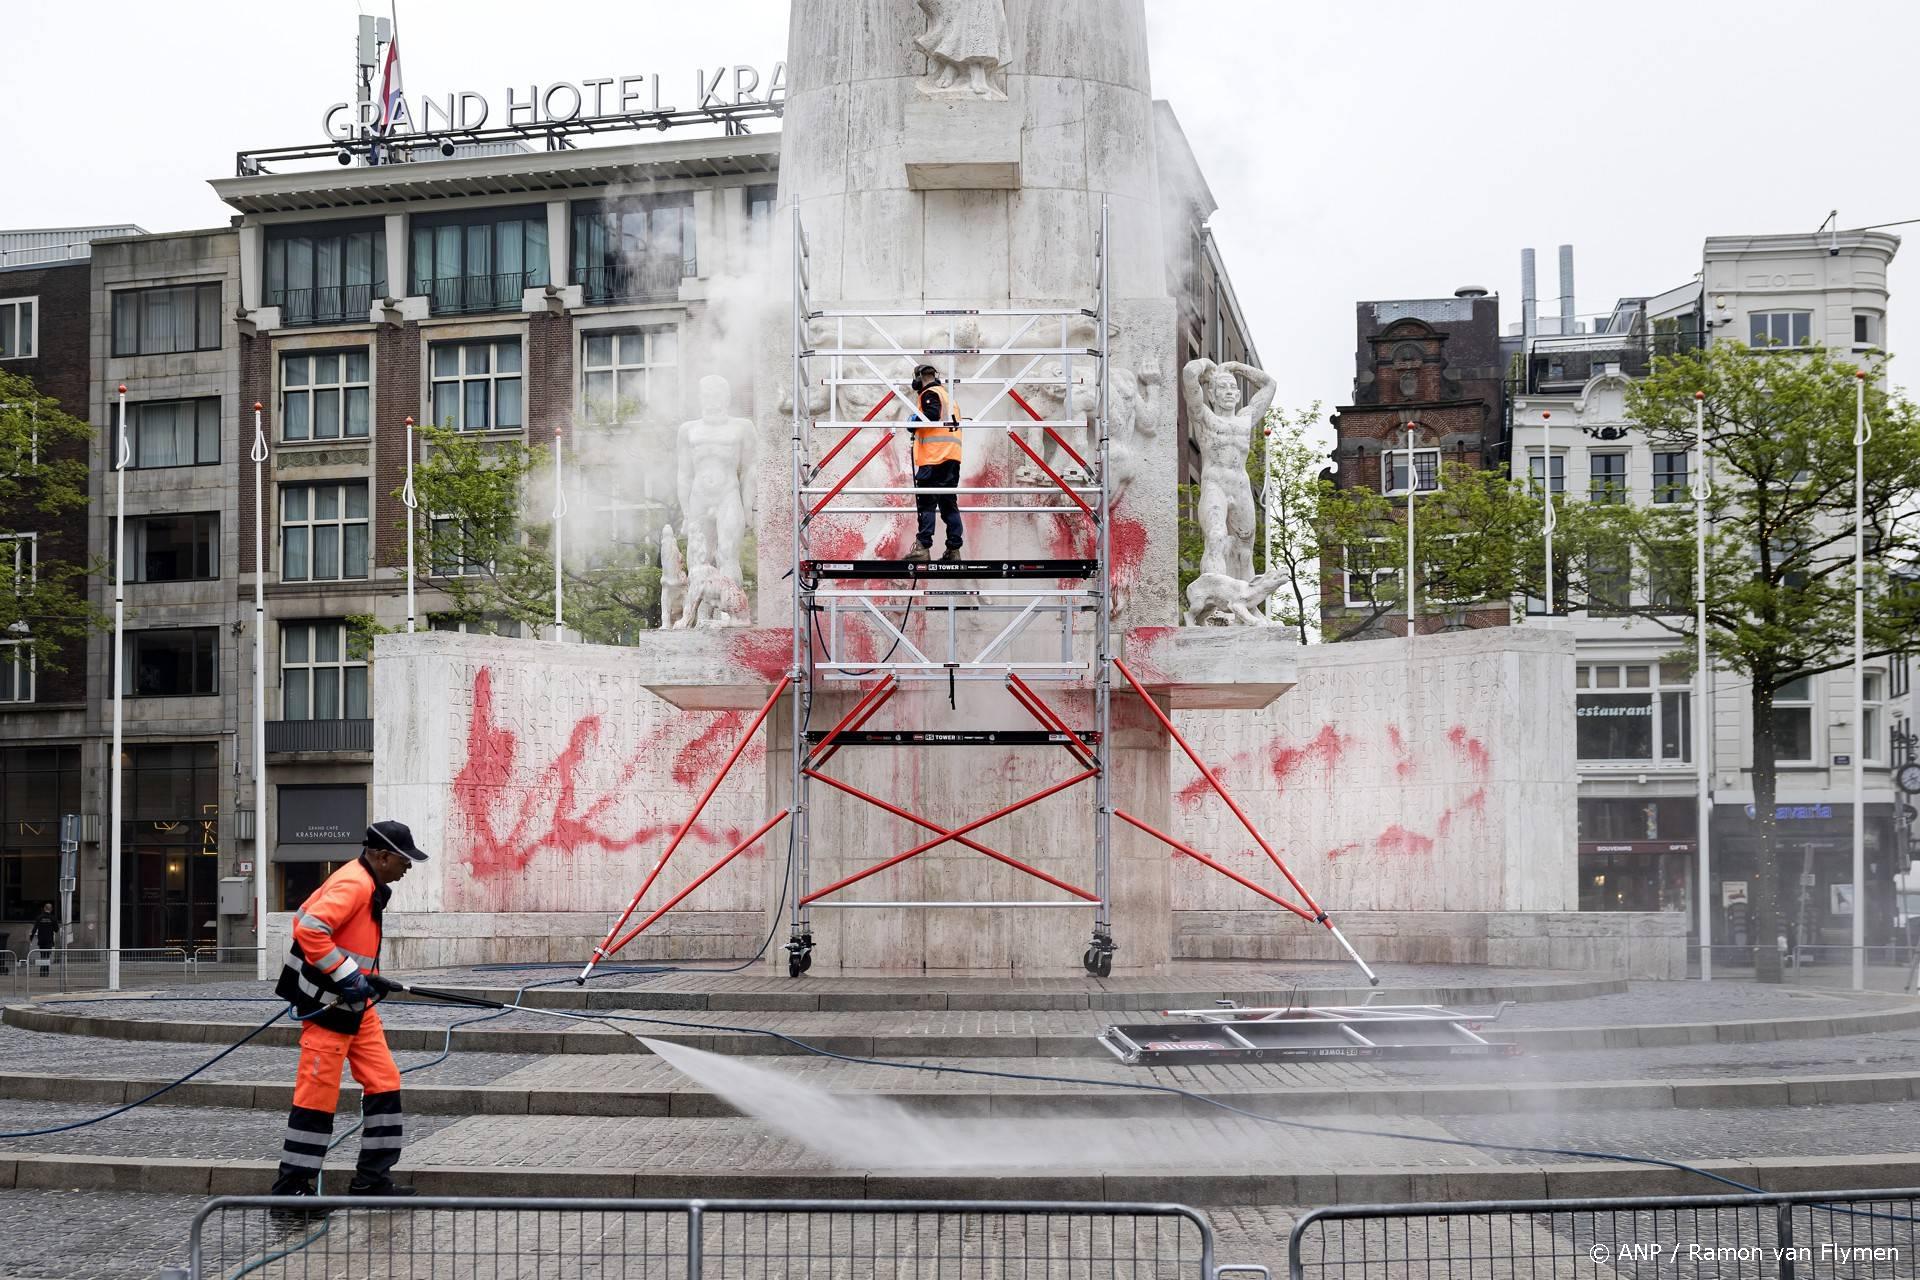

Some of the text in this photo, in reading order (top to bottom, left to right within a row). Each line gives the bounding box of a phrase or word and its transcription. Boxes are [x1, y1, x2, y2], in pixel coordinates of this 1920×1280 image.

[321, 91, 489, 141] GRAND
[506, 73, 676, 128] HOTEL
[1420, 662, 1446, 685] DE
[1455, 659, 1499, 682] ZON
[1330, 690, 1443, 714] GESLAGEN
[1577, 704, 1652, 717] estaurant
[1776, 803, 1832, 819] avaria
